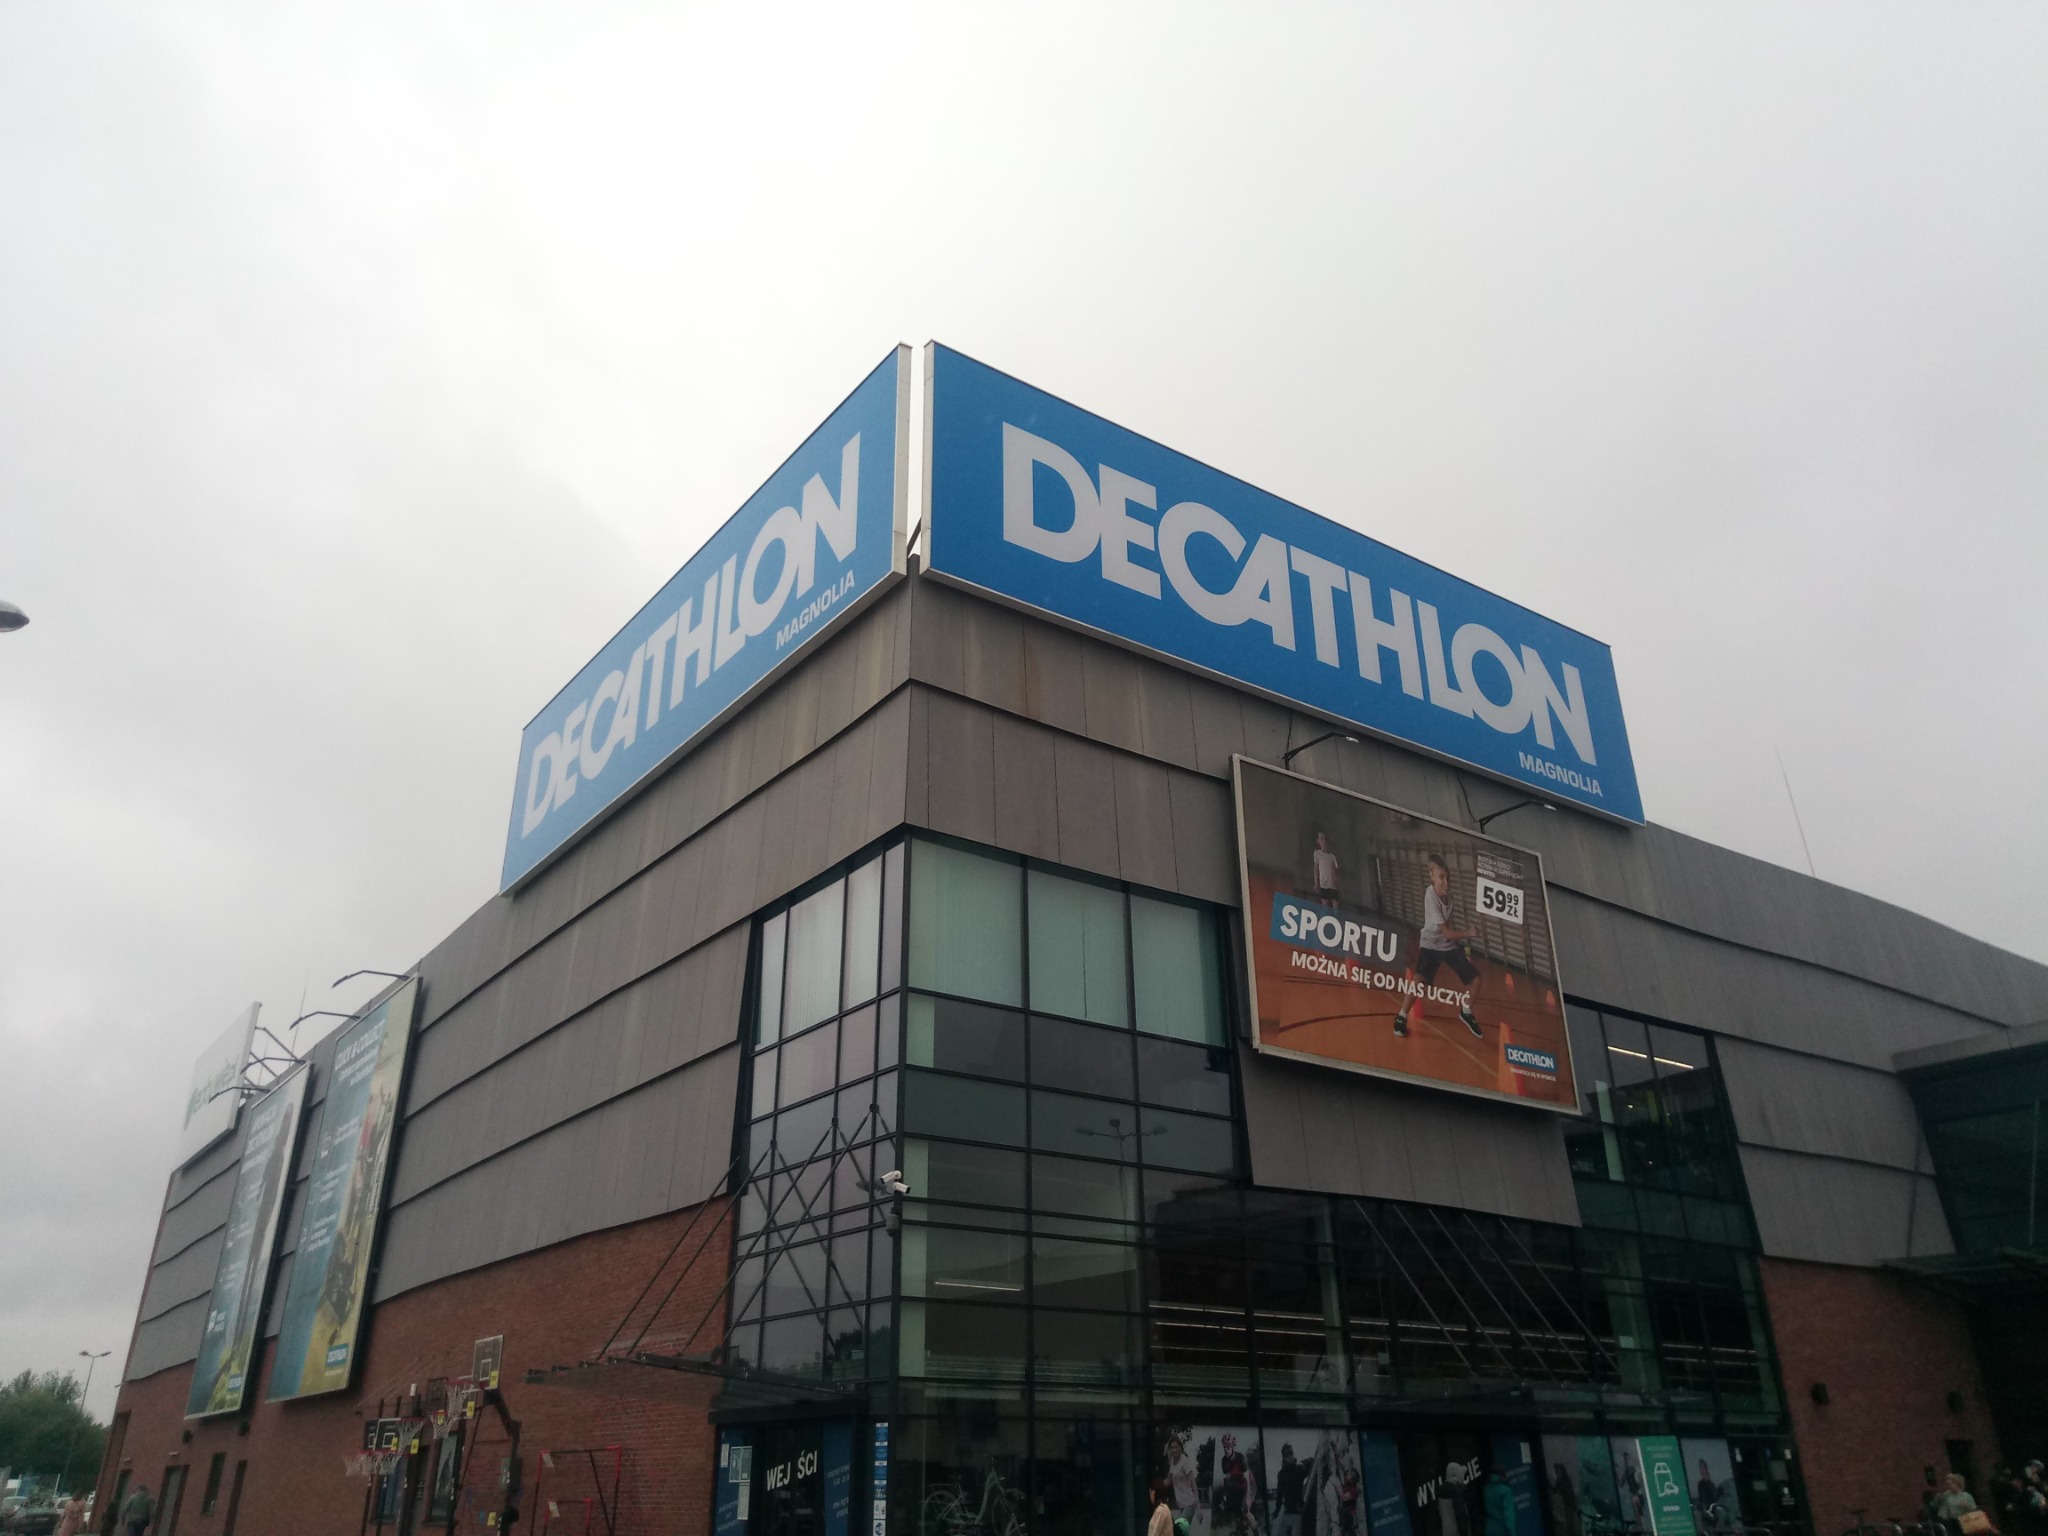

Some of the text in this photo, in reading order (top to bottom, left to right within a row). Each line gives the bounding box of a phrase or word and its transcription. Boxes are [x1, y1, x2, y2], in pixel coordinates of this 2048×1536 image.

[776, 569, 856, 651] MAGNOLIA
[1002, 421, 1597, 766] DECATHLON
[522, 430, 861, 839] DECATHLON
[1518, 751, 1603, 797] MAGNOLIA
[1482, 886, 1519, 912] 59 99
[1507, 904, 1519, 918] ZŁ
[1280, 905, 1398, 962] SPORTU
[1291, 951, 1471, 1009] MOŻNA SIĘ OD NAS UCZYĆ
[1507, 1048, 1554, 1069] DECATHLON
